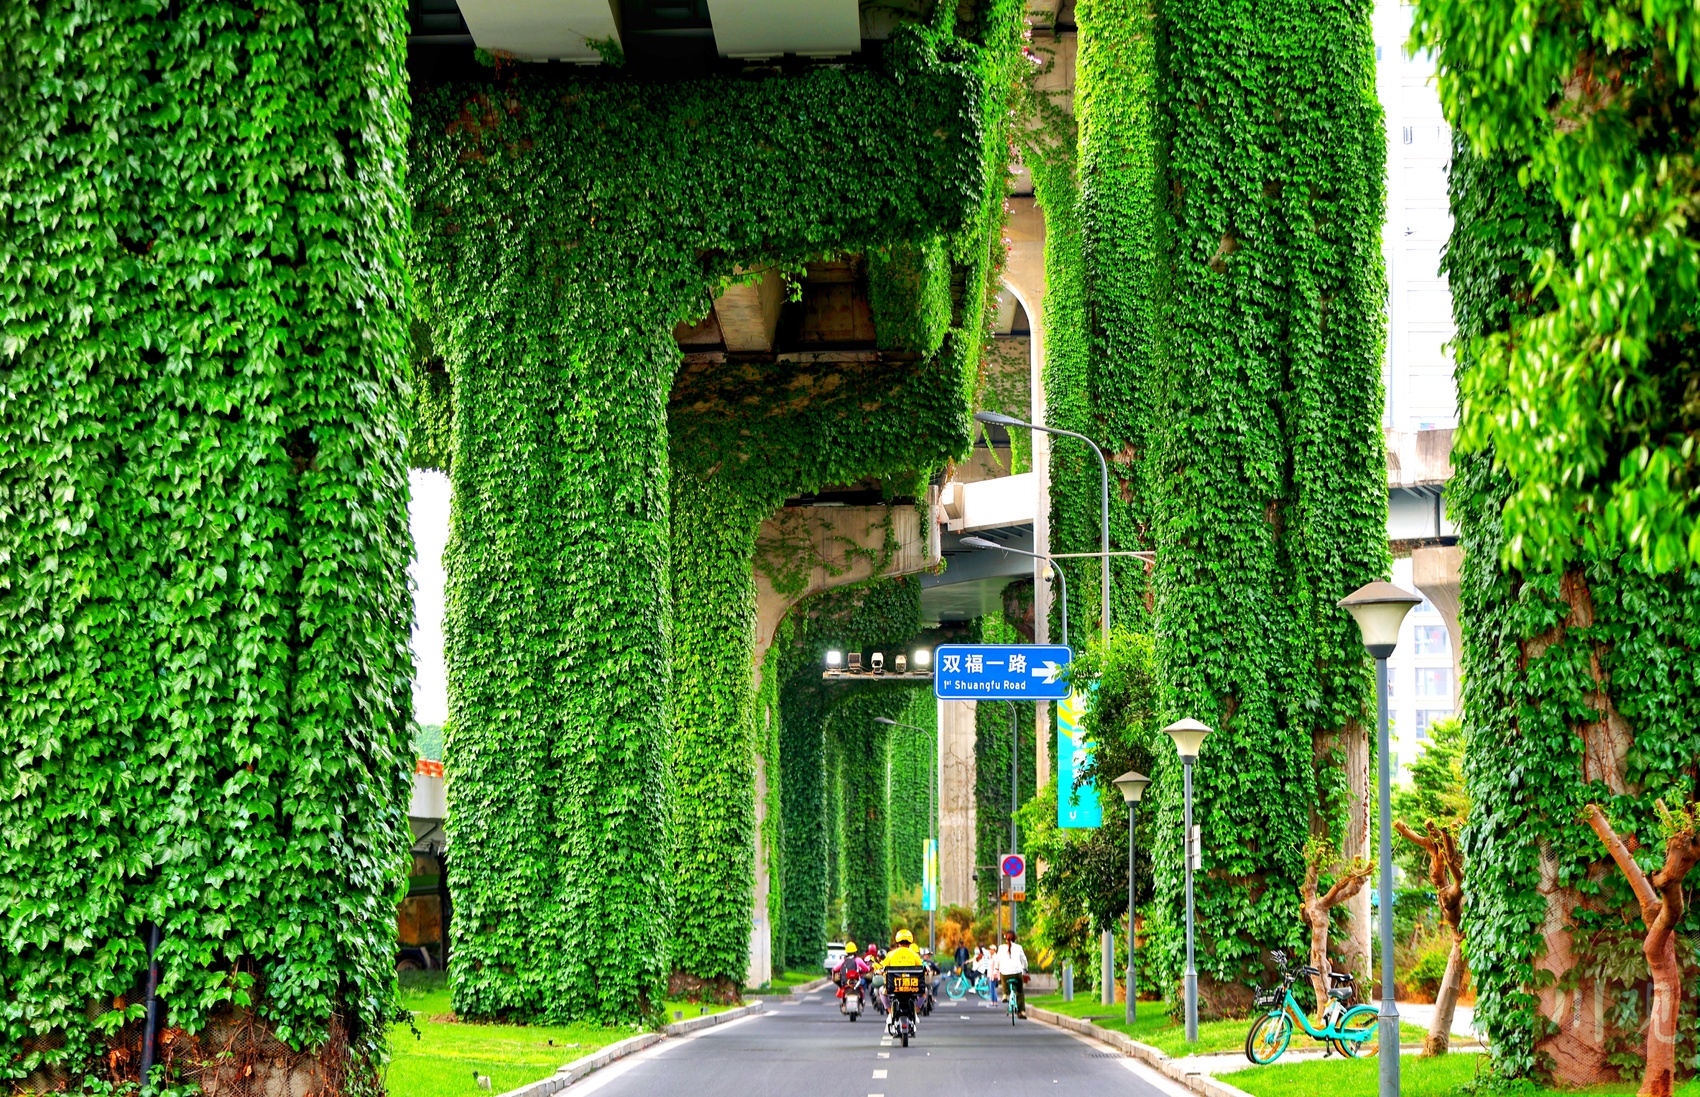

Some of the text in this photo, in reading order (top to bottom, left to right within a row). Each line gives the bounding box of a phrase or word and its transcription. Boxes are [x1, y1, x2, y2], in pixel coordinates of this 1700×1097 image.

[942, 654, 1028, 674] 双福一路
[944, 680, 1026, 692] 1st Shuangfu Road
